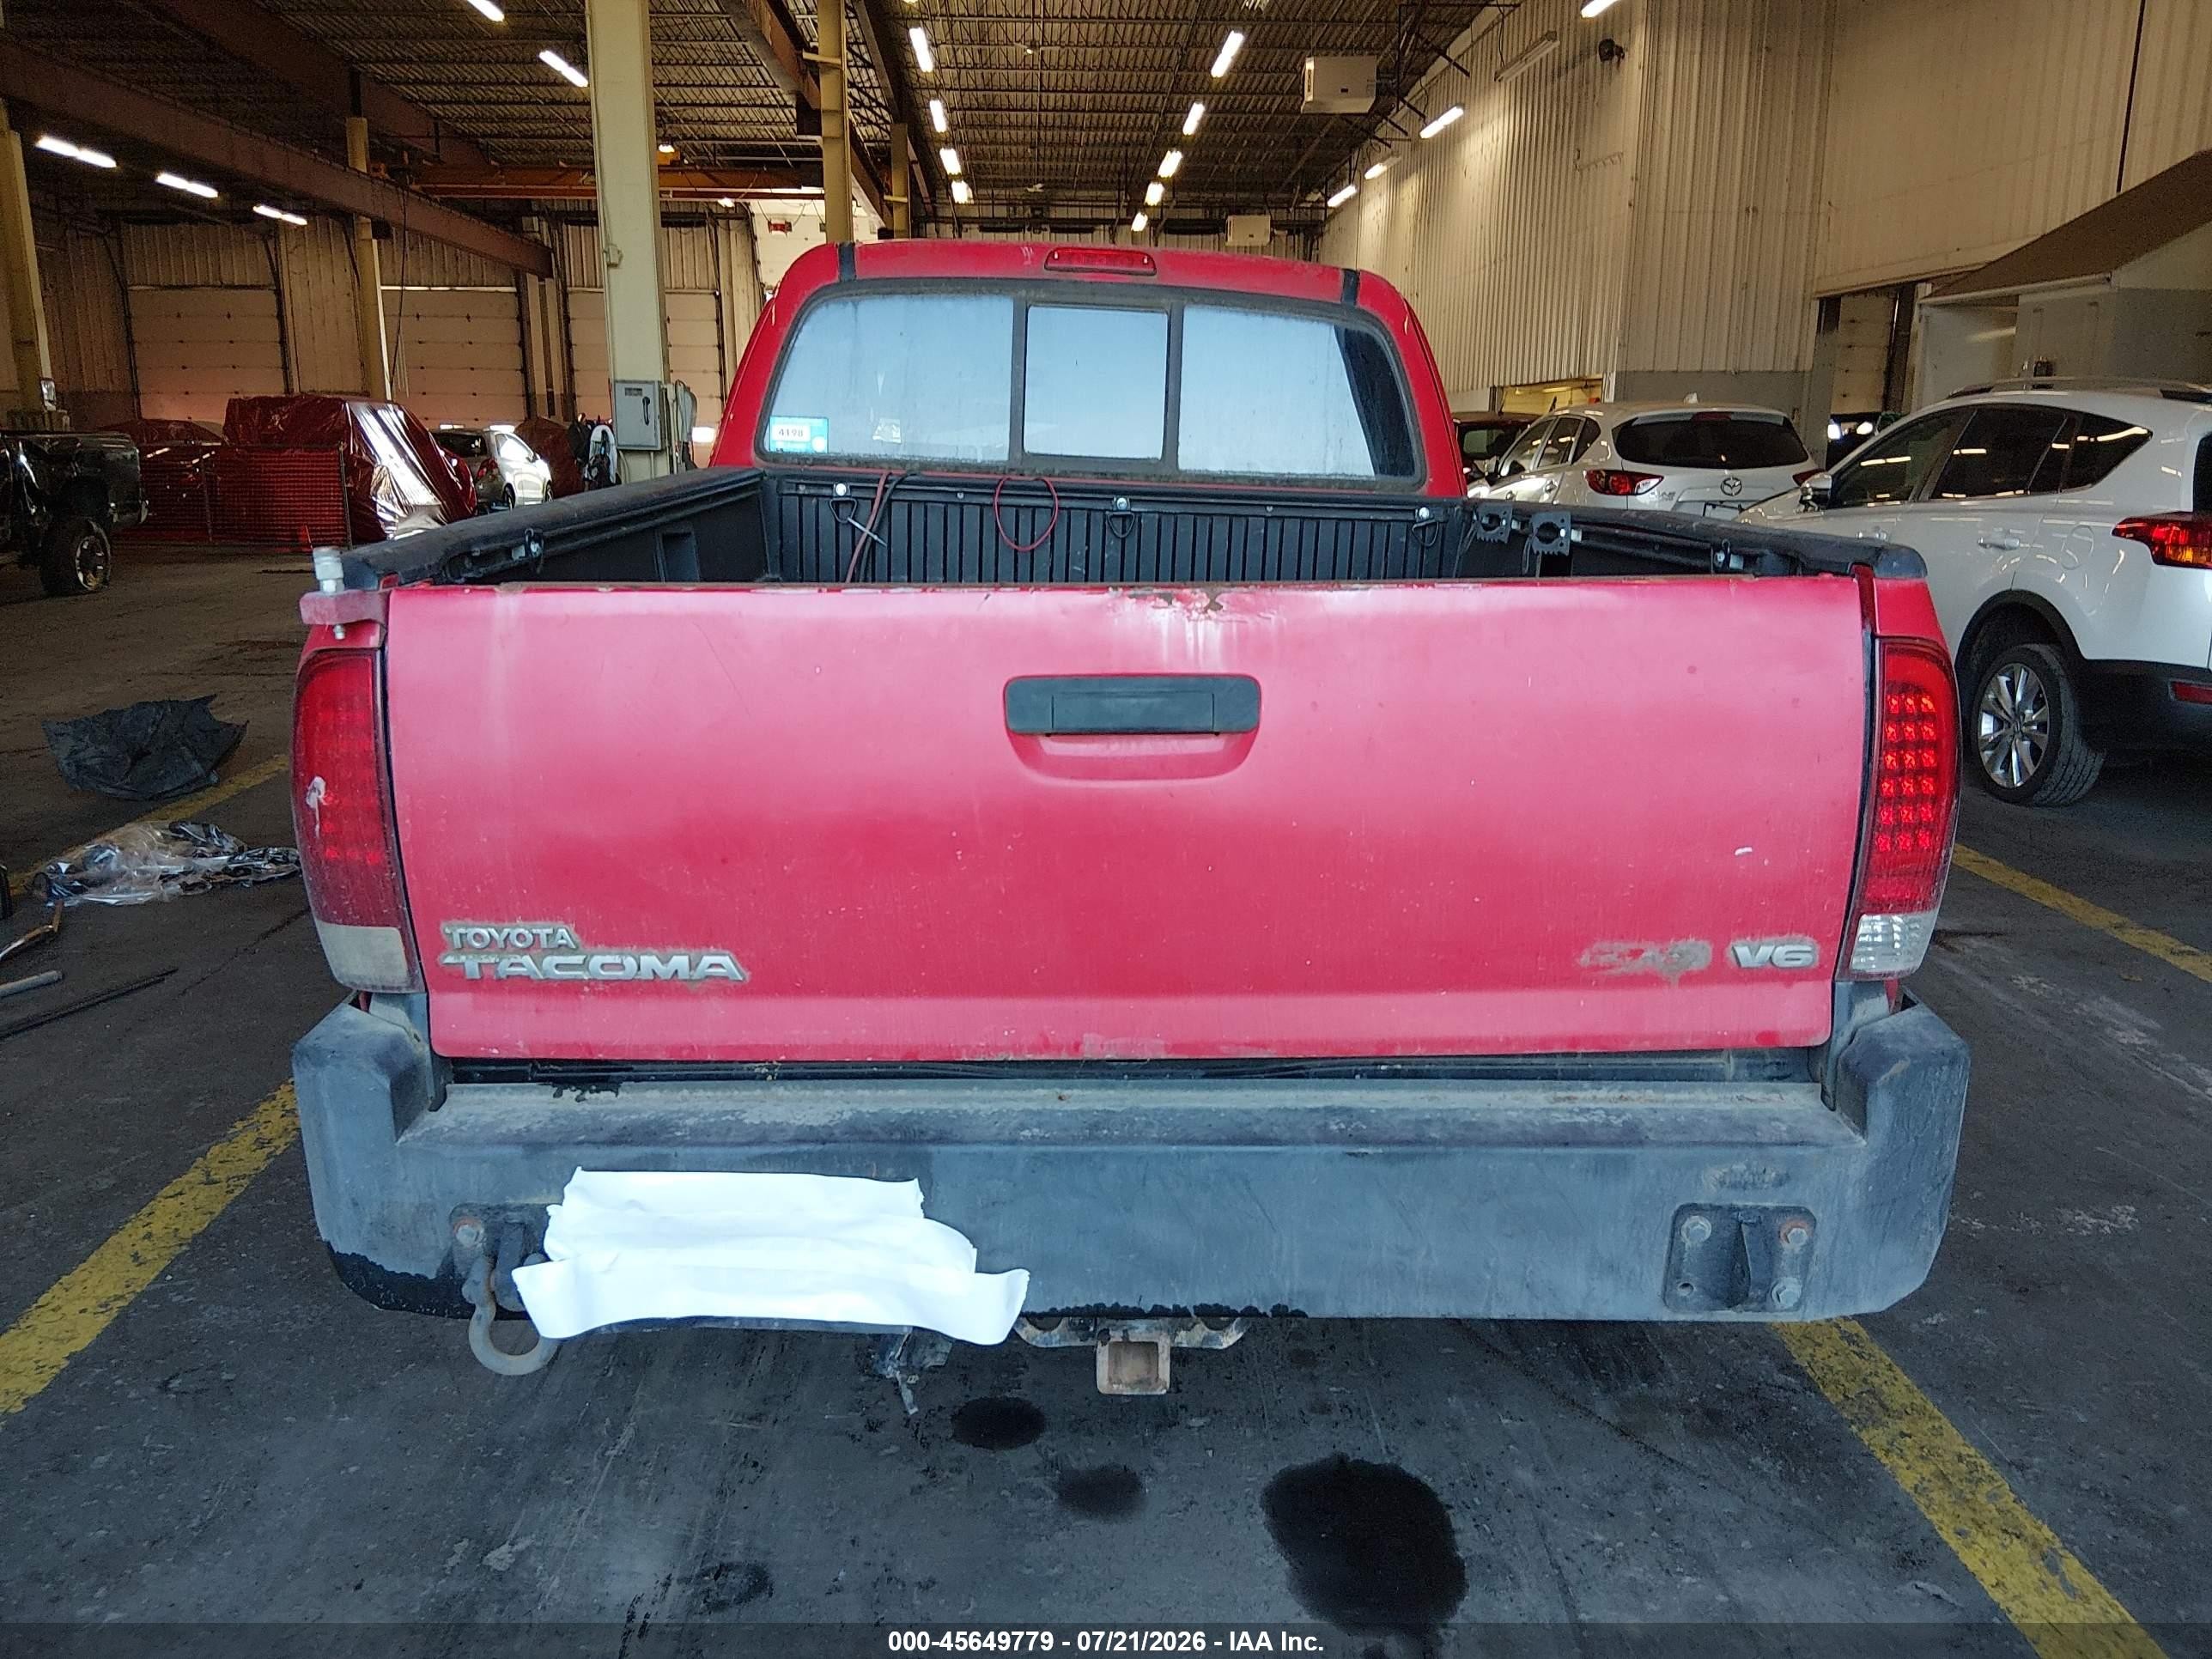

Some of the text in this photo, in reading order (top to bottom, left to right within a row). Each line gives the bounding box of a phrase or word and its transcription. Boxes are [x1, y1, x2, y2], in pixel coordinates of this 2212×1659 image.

[445, 927, 576, 949] TOYOTA
[442, 954, 744, 981] TACOMA
[1731, 944, 1814, 969] V6
